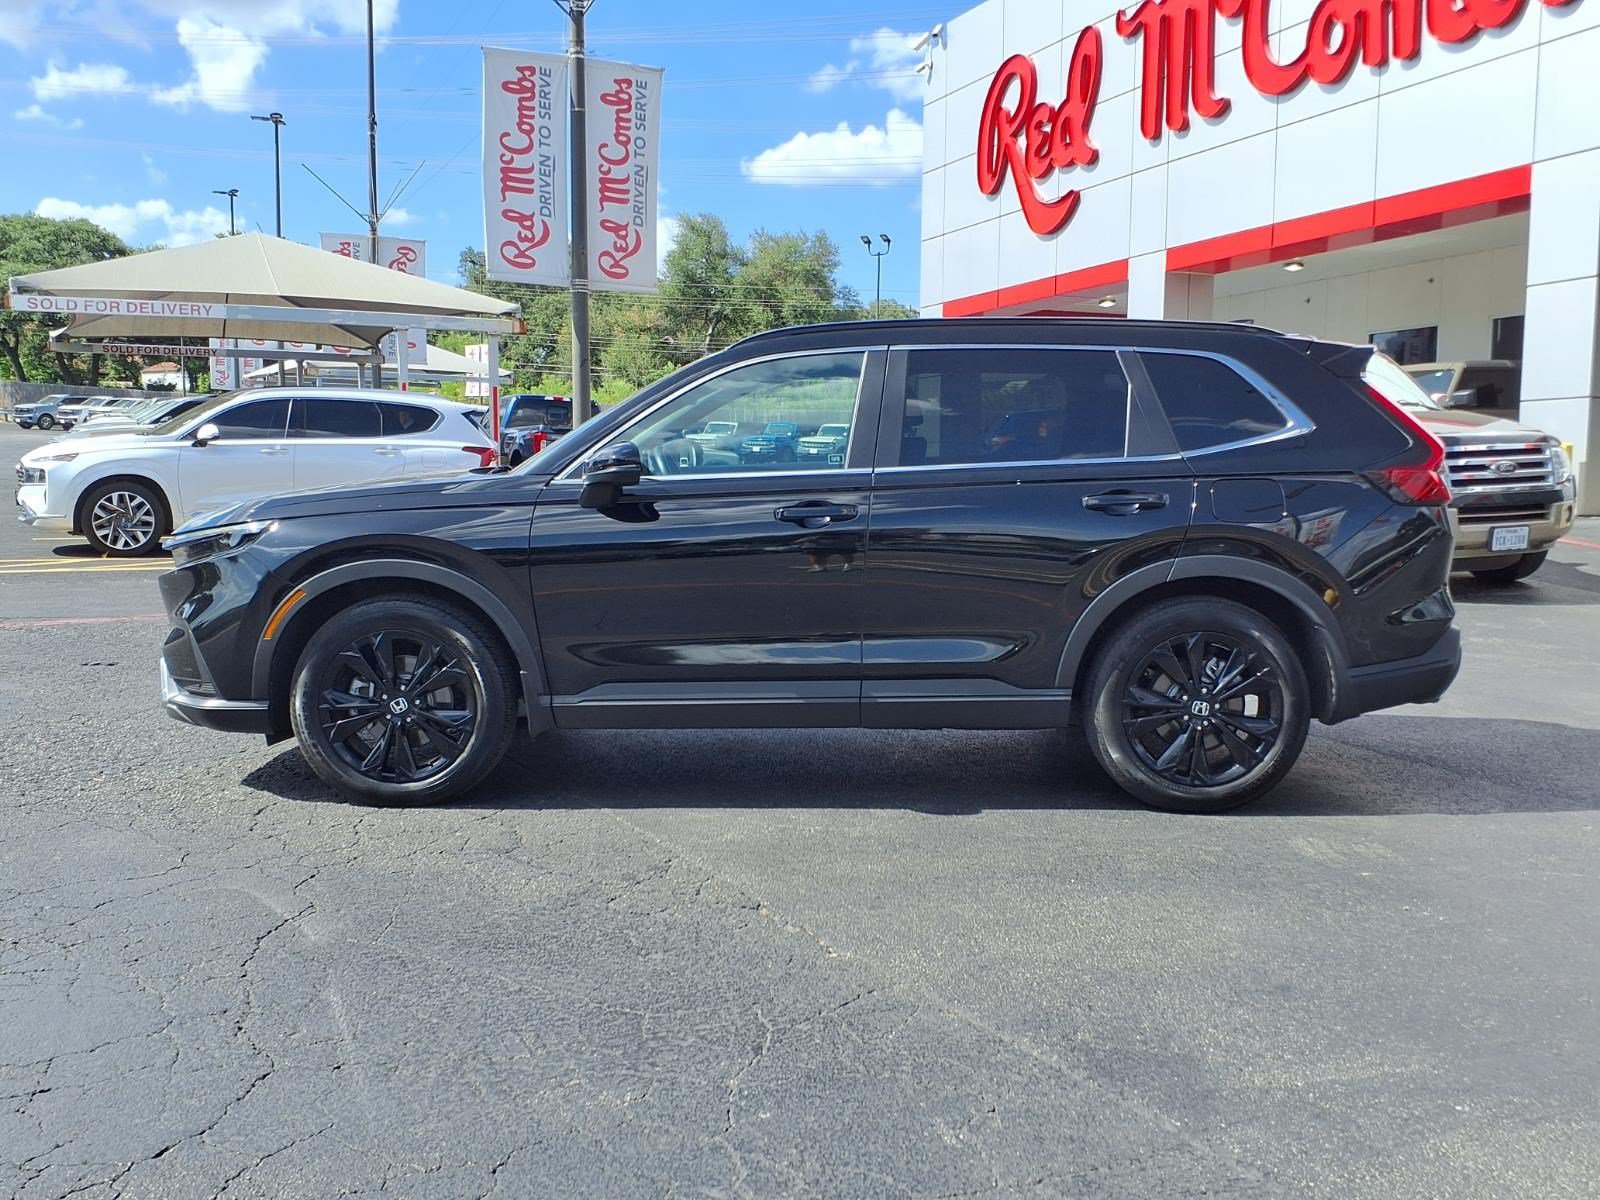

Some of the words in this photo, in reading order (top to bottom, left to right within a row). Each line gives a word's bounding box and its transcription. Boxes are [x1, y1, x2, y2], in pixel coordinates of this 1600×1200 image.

[539, 66, 552, 121] SERVE
[635, 79, 648, 131] SERVE
[500, 65, 536, 203] McCombs
[539, 125, 551, 148] TO
[598, 78, 633, 213] McCombs
[634, 136, 646, 159] TO
[977, 25, 1103, 235] Red
[539, 154, 552, 218] DRIVEN
[633, 164, 645, 228] DRIVEN
[500, 208, 550, 269] Red
[598, 219, 642, 280] Red
[27, 297, 78, 311] SOLD
[84, 300, 121, 313] FOR
[126, 302, 213, 316] DELIVERY
[102, 344, 133, 354] SOLD
[137, 346, 159, 355] FOR
[163, 347, 218, 357] DELIVERY
